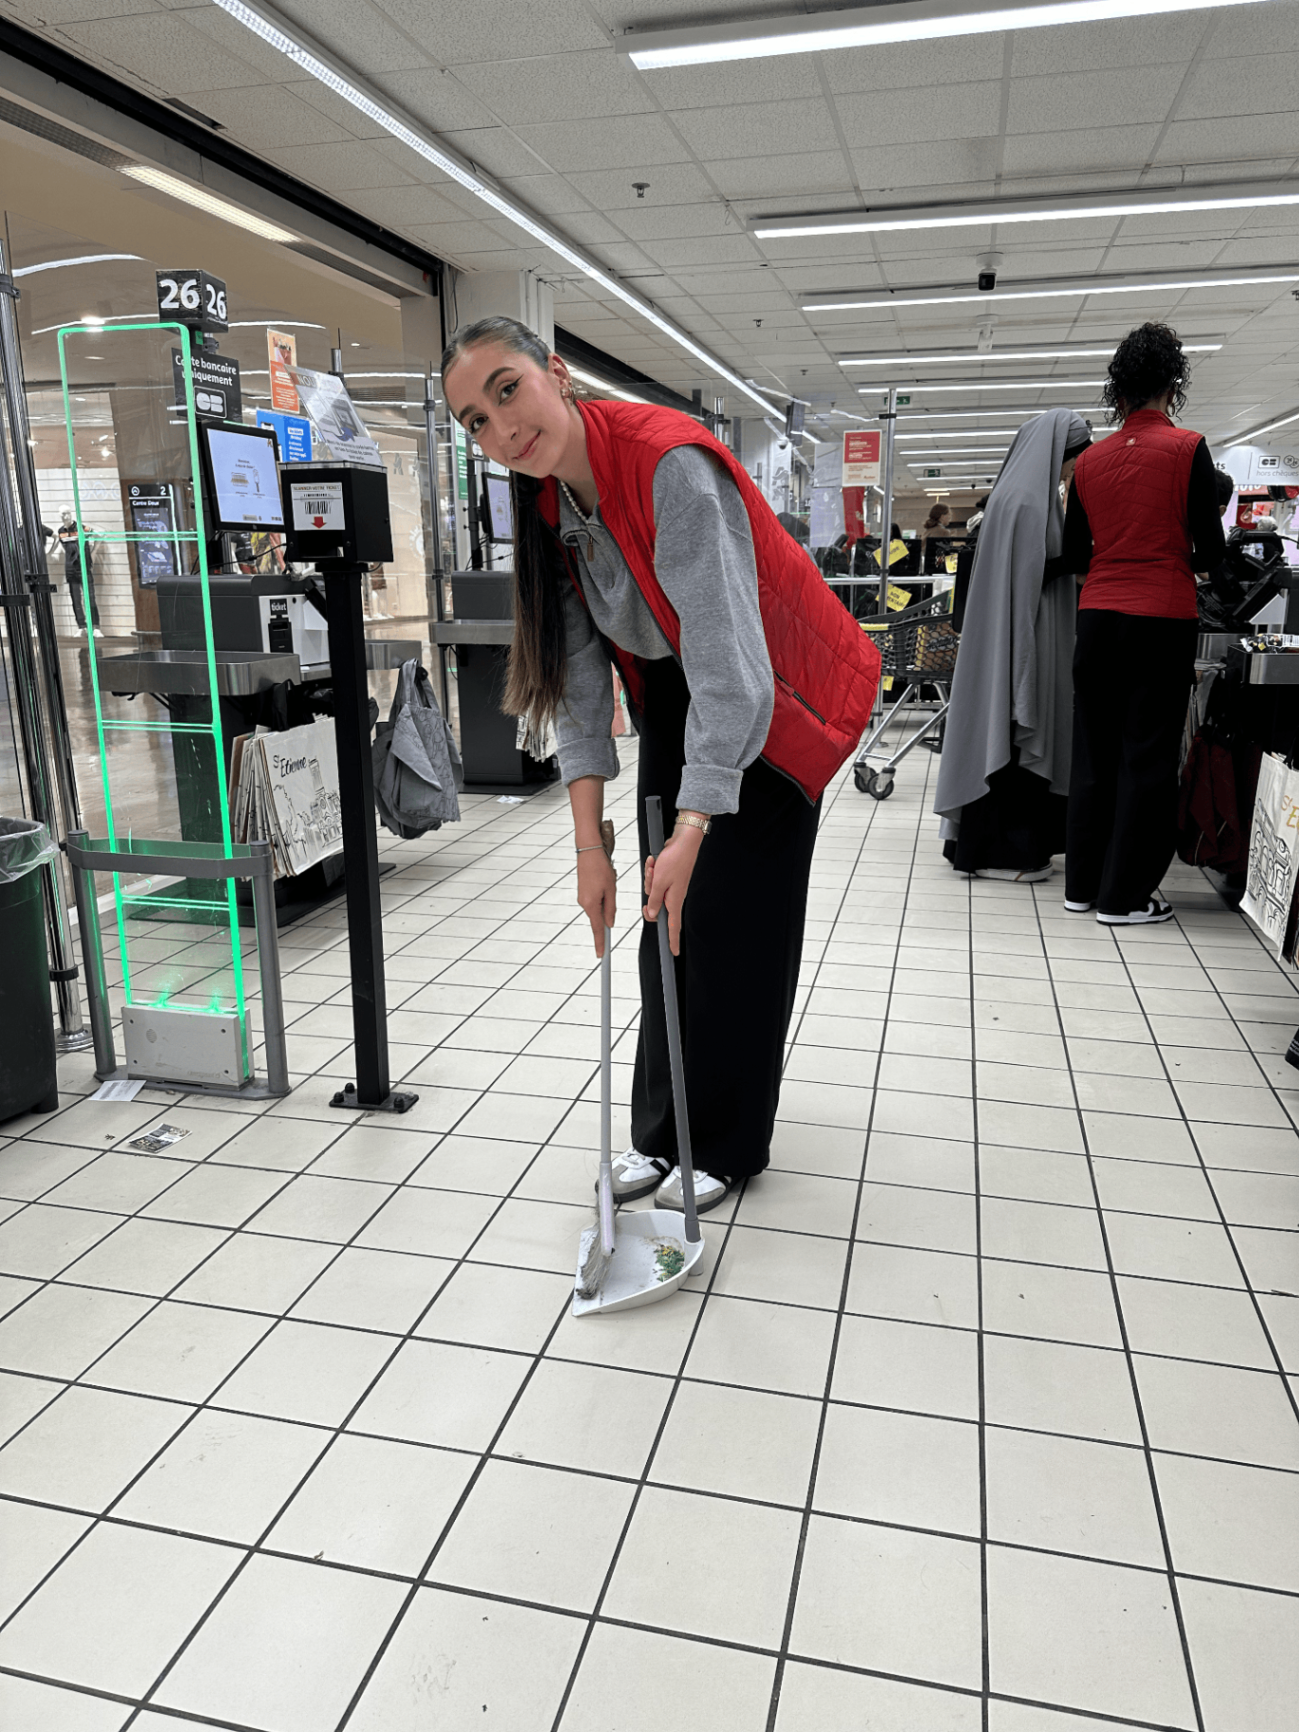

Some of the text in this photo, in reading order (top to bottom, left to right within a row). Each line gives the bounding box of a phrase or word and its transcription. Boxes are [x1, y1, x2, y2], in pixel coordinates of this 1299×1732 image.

[160, 279, 200, 309] 26
[206, 283, 226, 319] 26
[175, 355, 237, 375] Cte bancaire
[196, 392, 223, 413] CB
[160, 486, 167, 496] 2
[271, 602, 287, 611] ticket
[280, 756, 307, 778] Etienne
